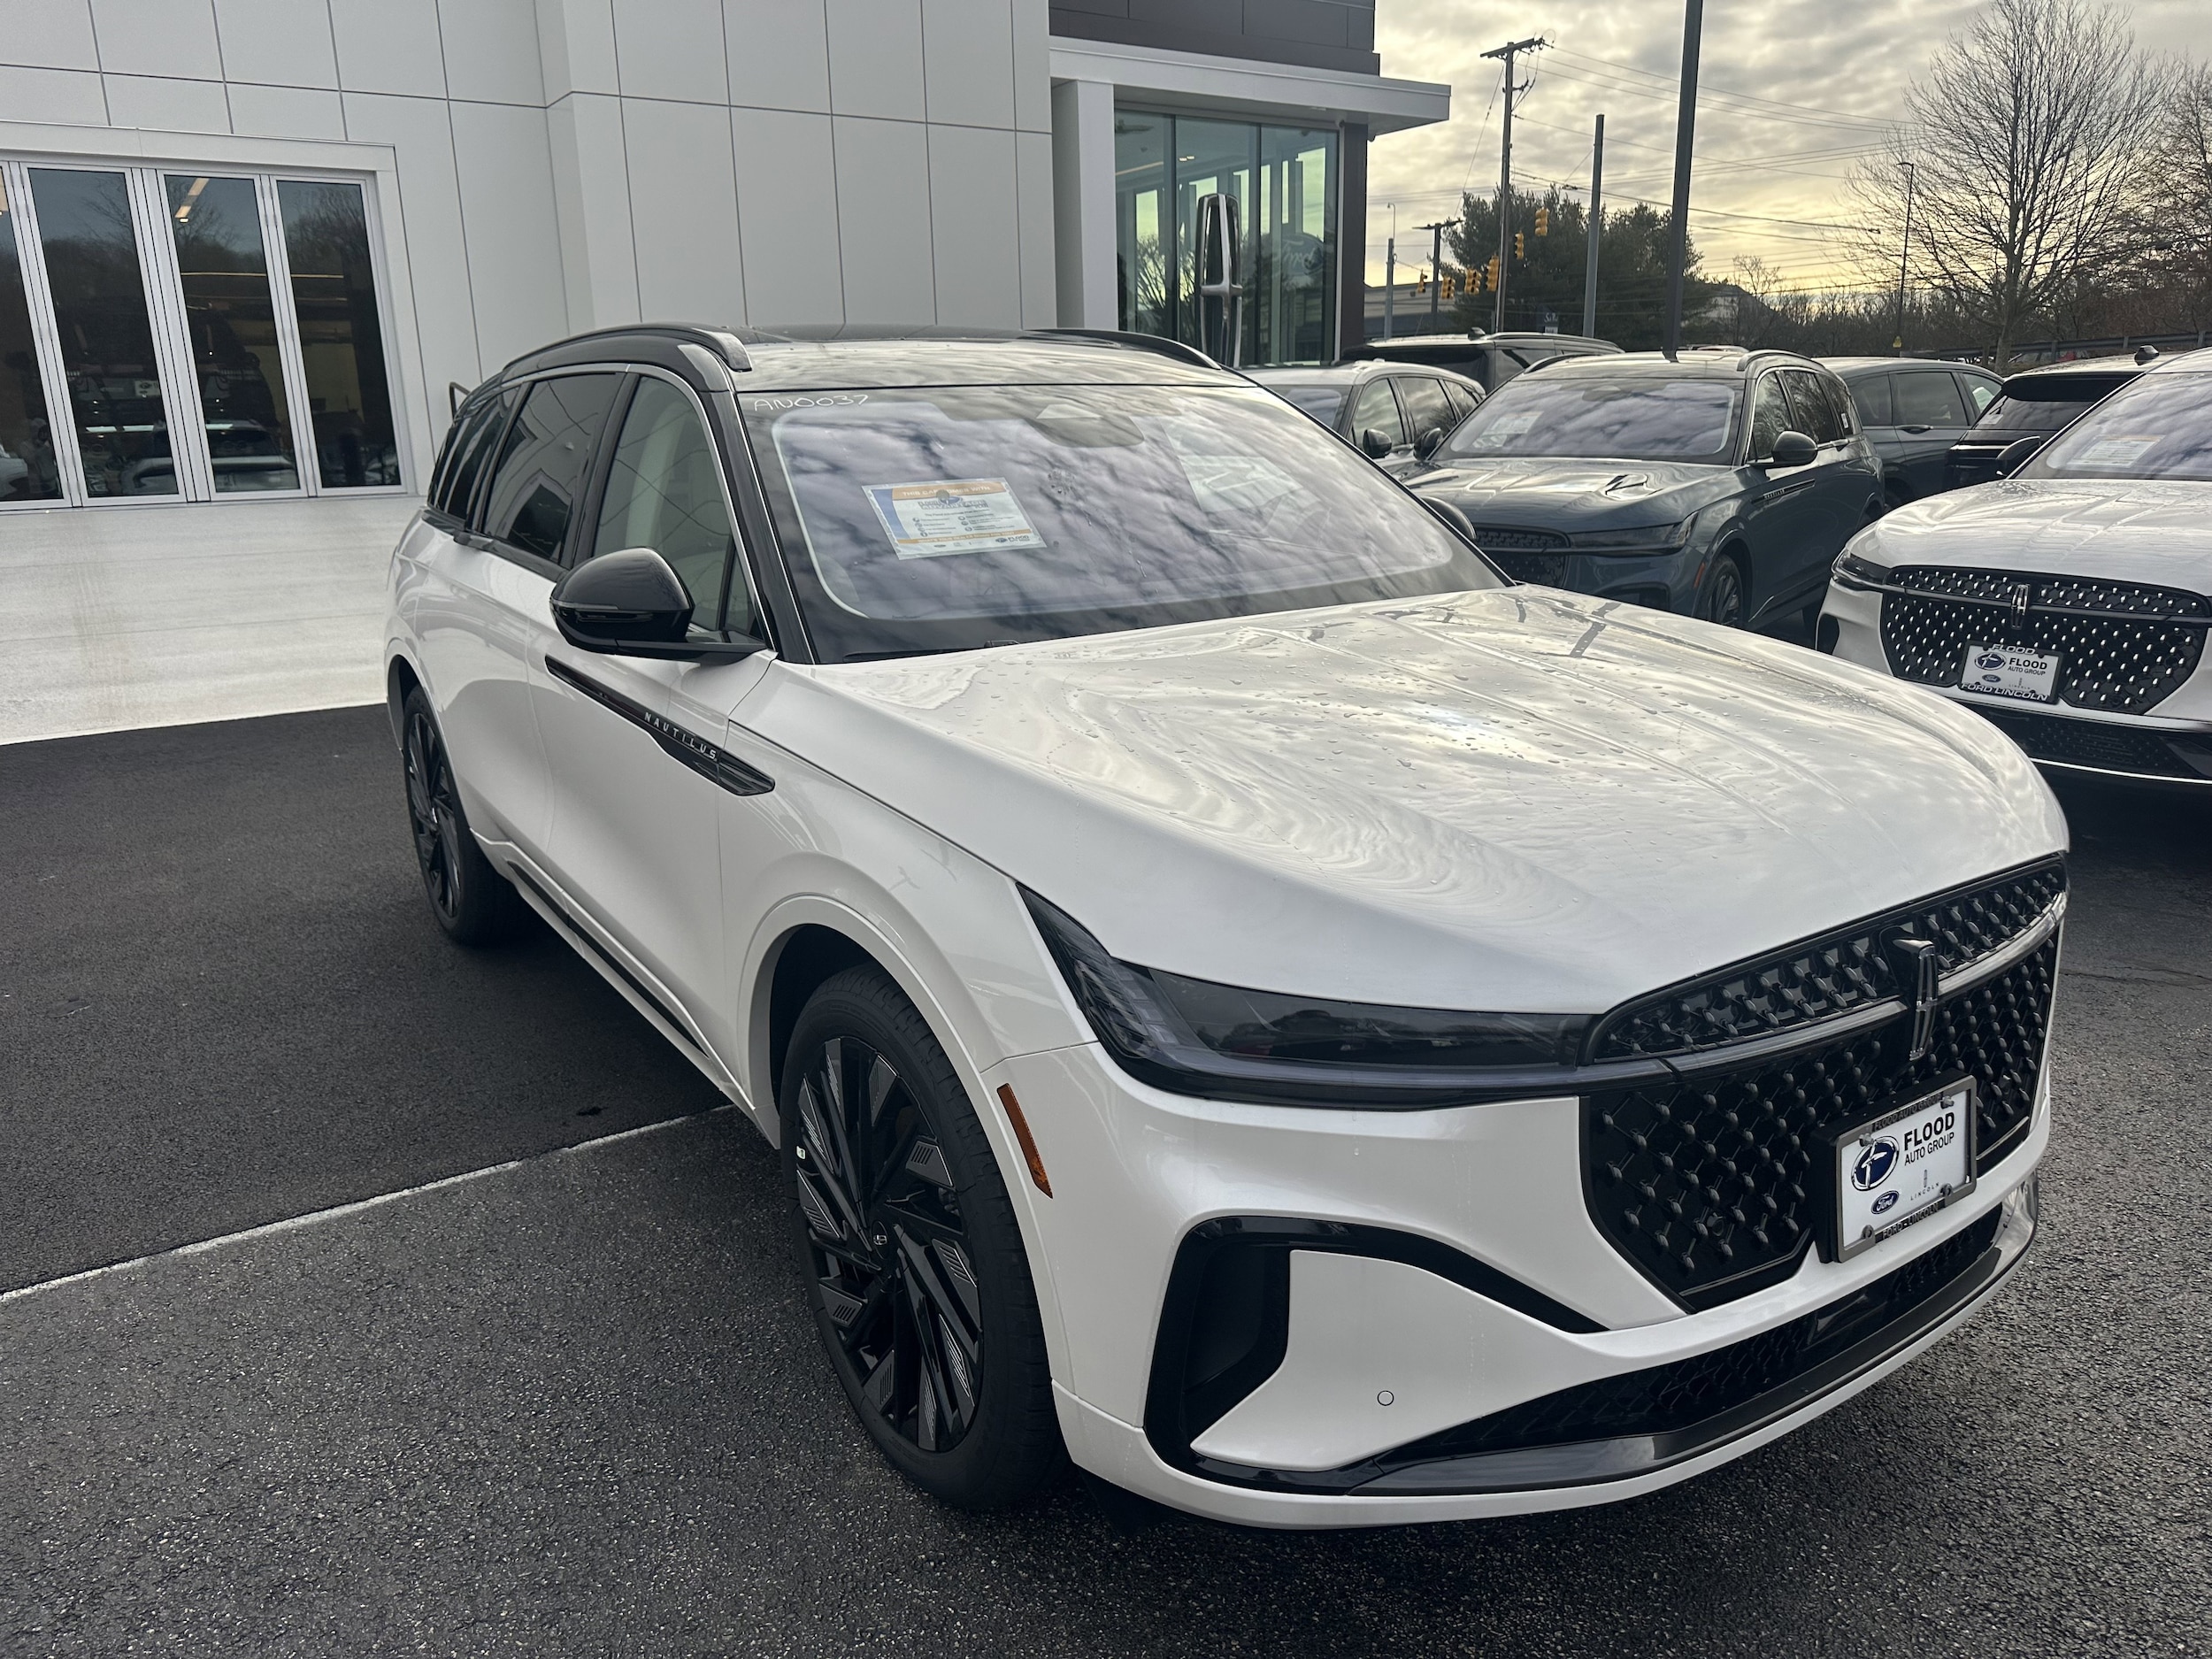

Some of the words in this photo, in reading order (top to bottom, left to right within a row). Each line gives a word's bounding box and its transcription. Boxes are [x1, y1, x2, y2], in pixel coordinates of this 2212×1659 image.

[1992, 643, 2036, 656] FLOOD
[2008, 657, 2047, 670] FLOOD
[1961, 682, 1993, 694] FORD
[1994, 687, 2048, 702] LINCOLN
[644, 711, 718, 760] NAUTILUS
[1874, 1112, 1899, 1131] FLOOD
[1899, 1103, 1918, 1121] AUTO
[1917, 1093, 1942, 1112] GROUP
[1903, 1112, 1955, 1151] FLOOD
[1905, 1147, 1925, 1166] AUTO
[1927, 1132, 1955, 1155] GROUP
[1910, 1182, 1939, 1201] LINCOLN
[1875, 1194, 1895, 1212] Ford
